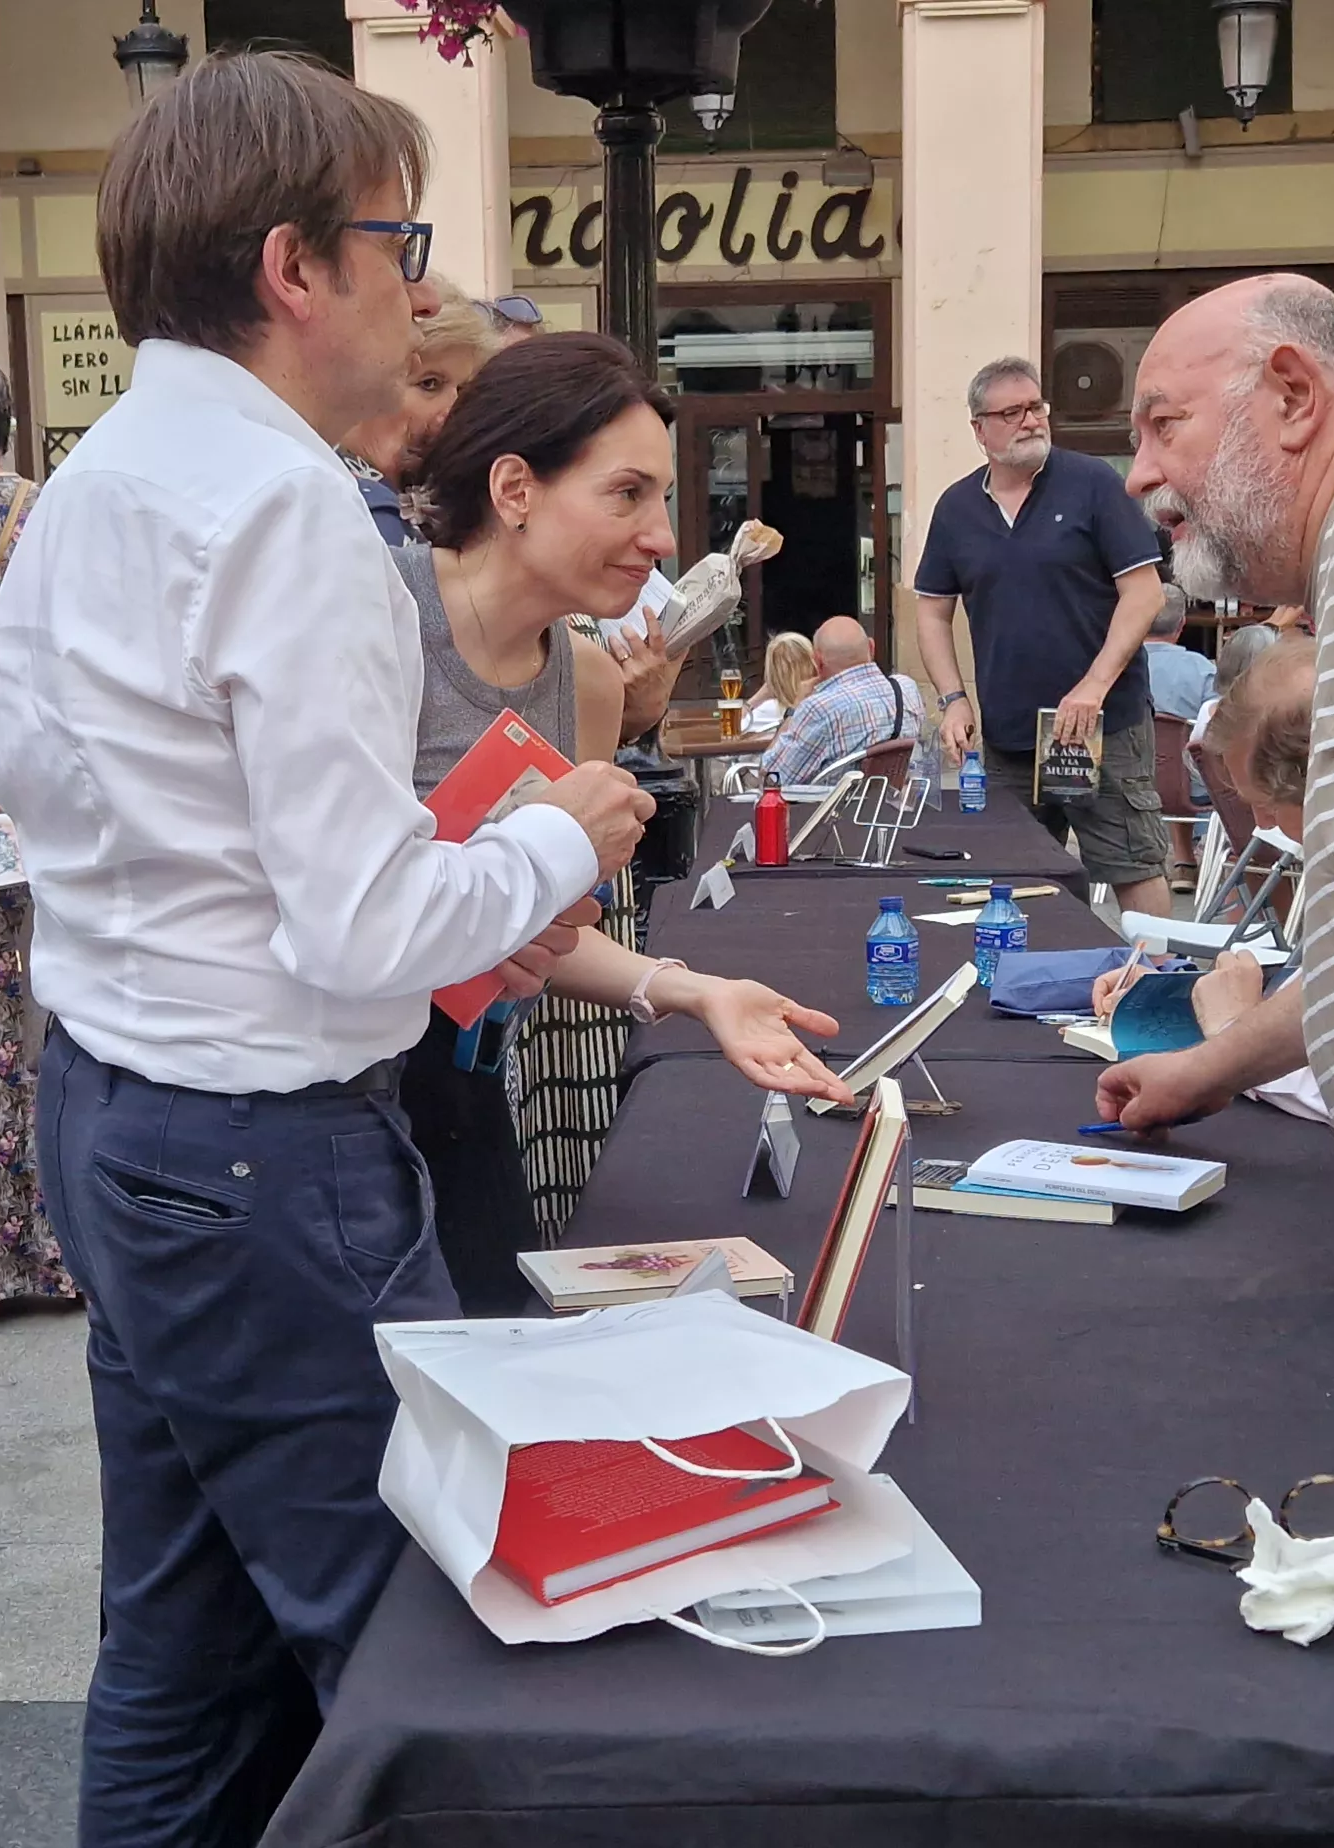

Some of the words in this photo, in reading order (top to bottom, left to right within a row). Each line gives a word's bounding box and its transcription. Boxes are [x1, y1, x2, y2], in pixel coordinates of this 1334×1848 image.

[53, 317, 121, 342] LLÁMA
[63, 351, 109, 368] PERO
[62, 377, 90, 397] SIN
[1044, 748, 1058, 757] EL
[1067, 758, 1080, 766] LA
[1045, 766, 1092, 777] MUERTE
